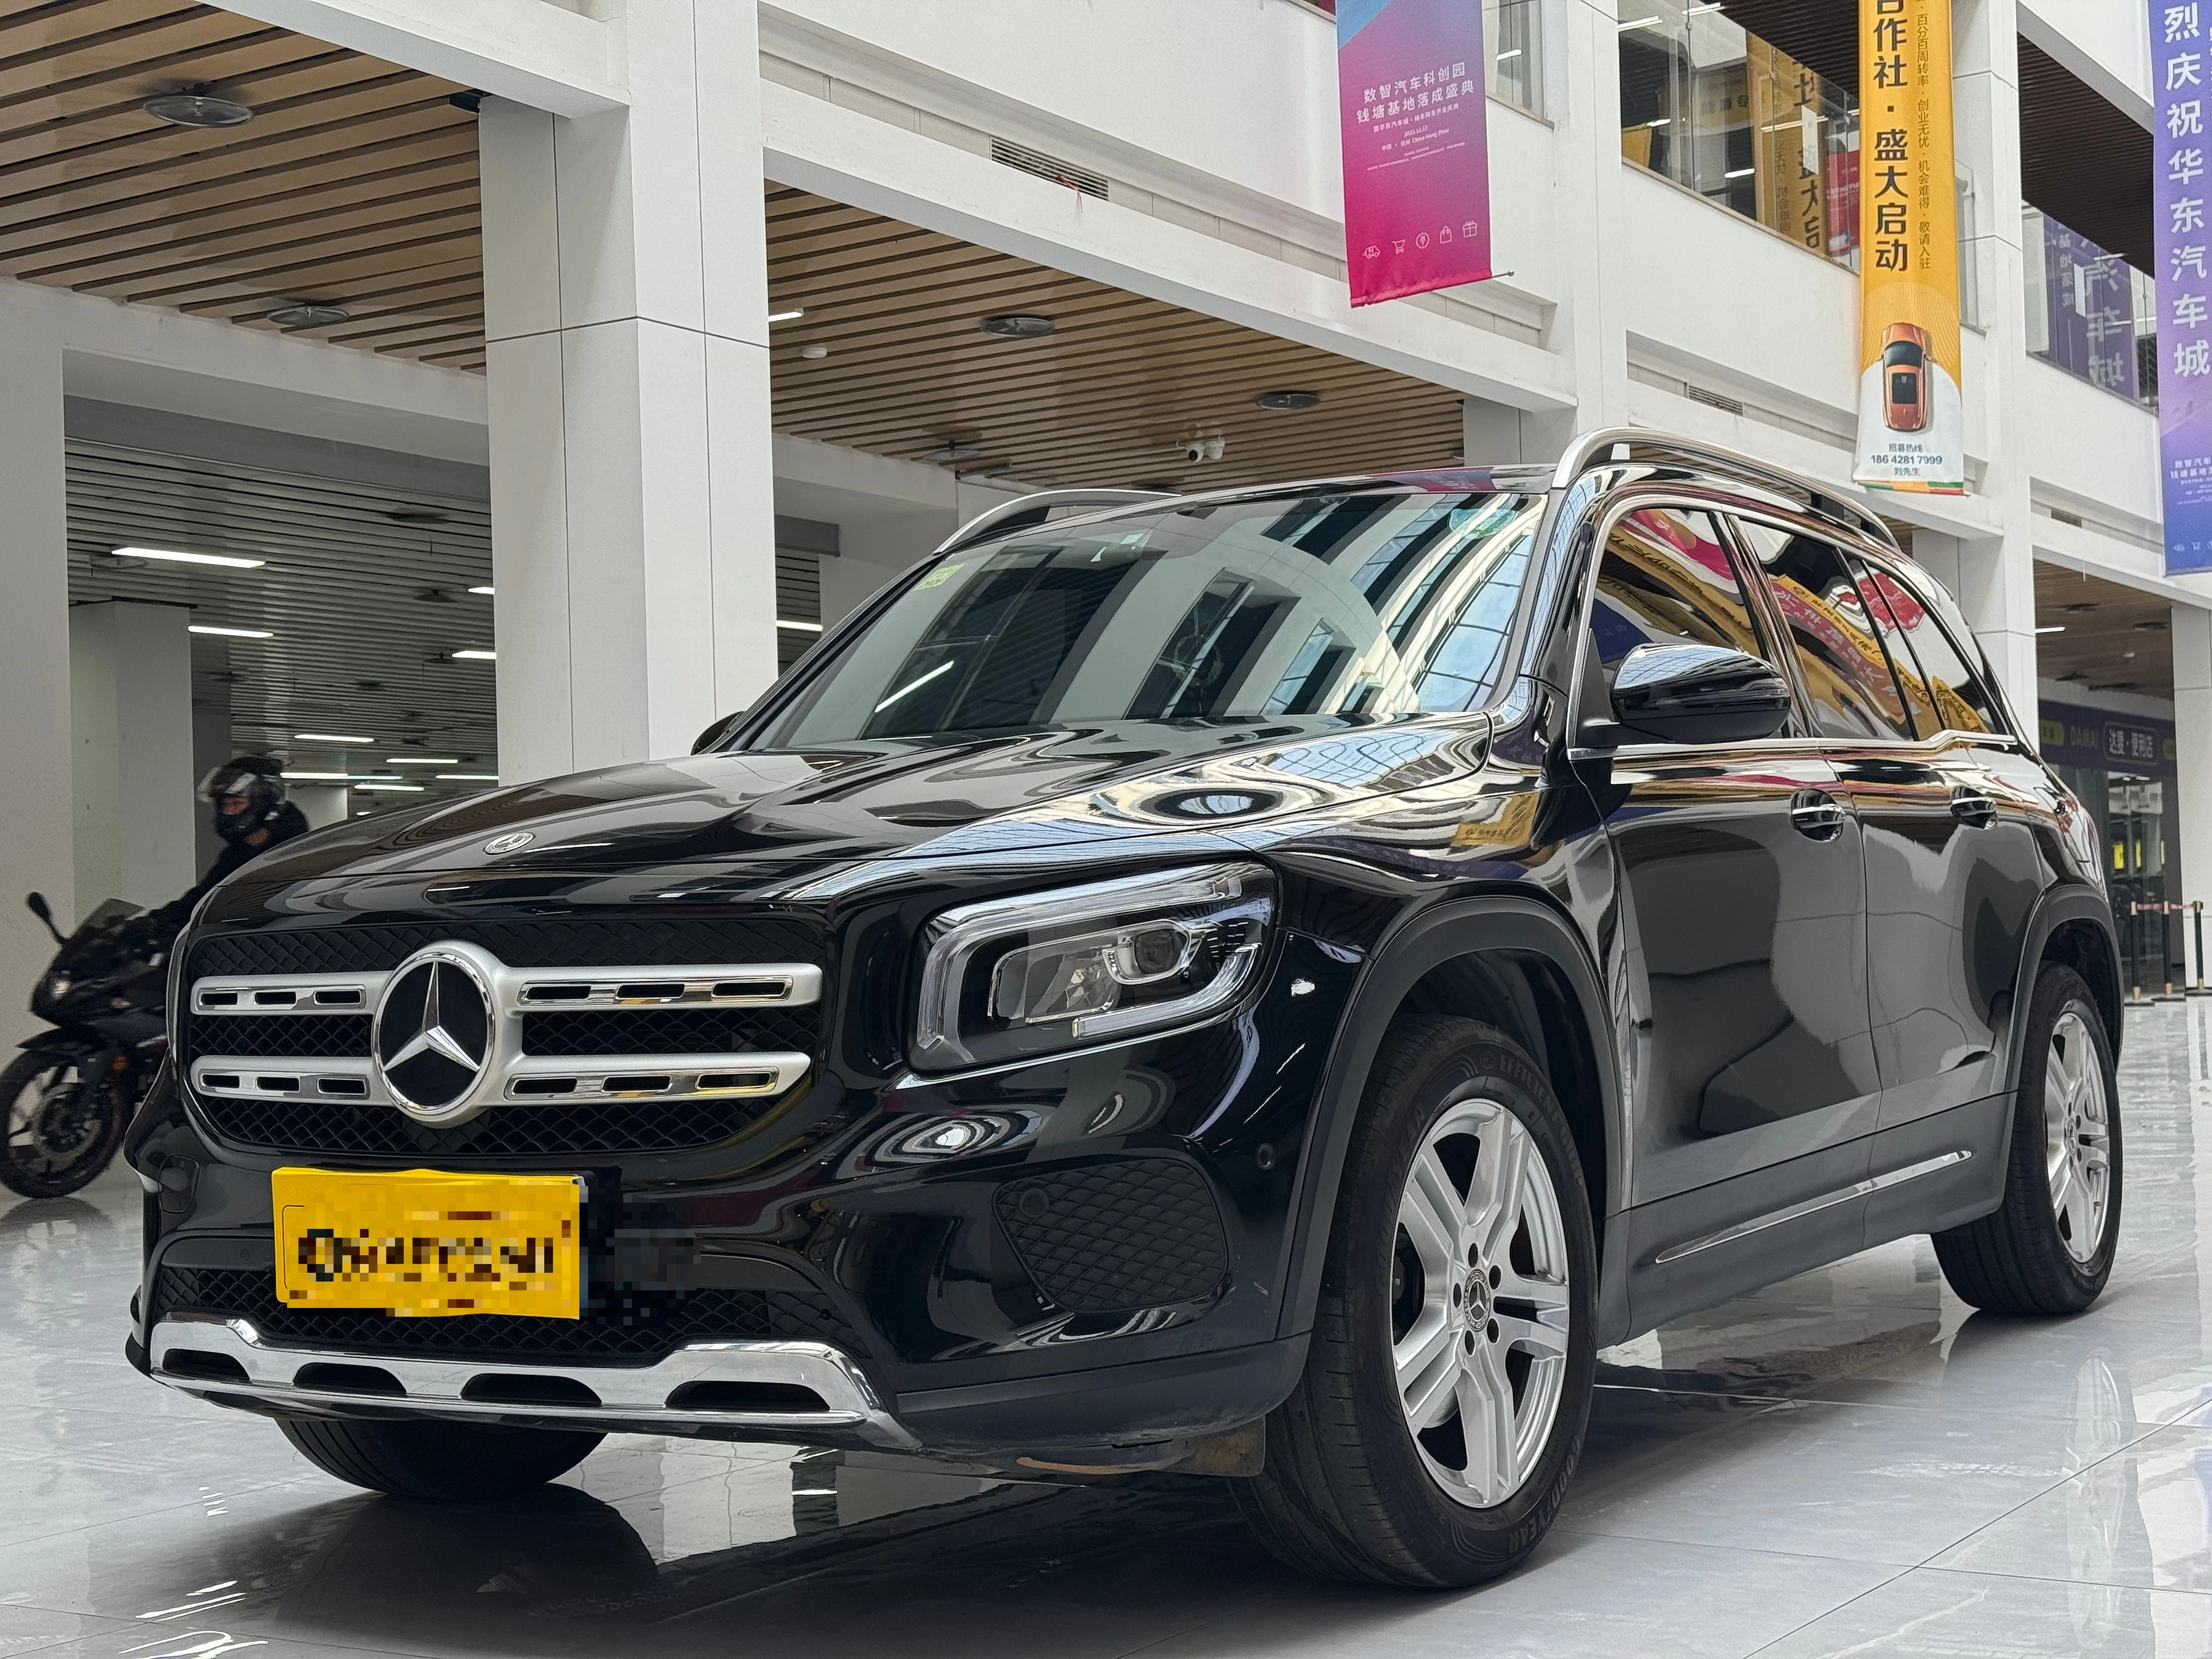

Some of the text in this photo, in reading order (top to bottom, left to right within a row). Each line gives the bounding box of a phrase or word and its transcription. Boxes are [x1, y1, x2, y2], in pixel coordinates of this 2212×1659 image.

[1357, 79, 1474, 124] 钱塘基地落成盛典
[1363, 62, 1465, 104] 数智汽车科创园
[1870, 454, 1889, 464] 186
